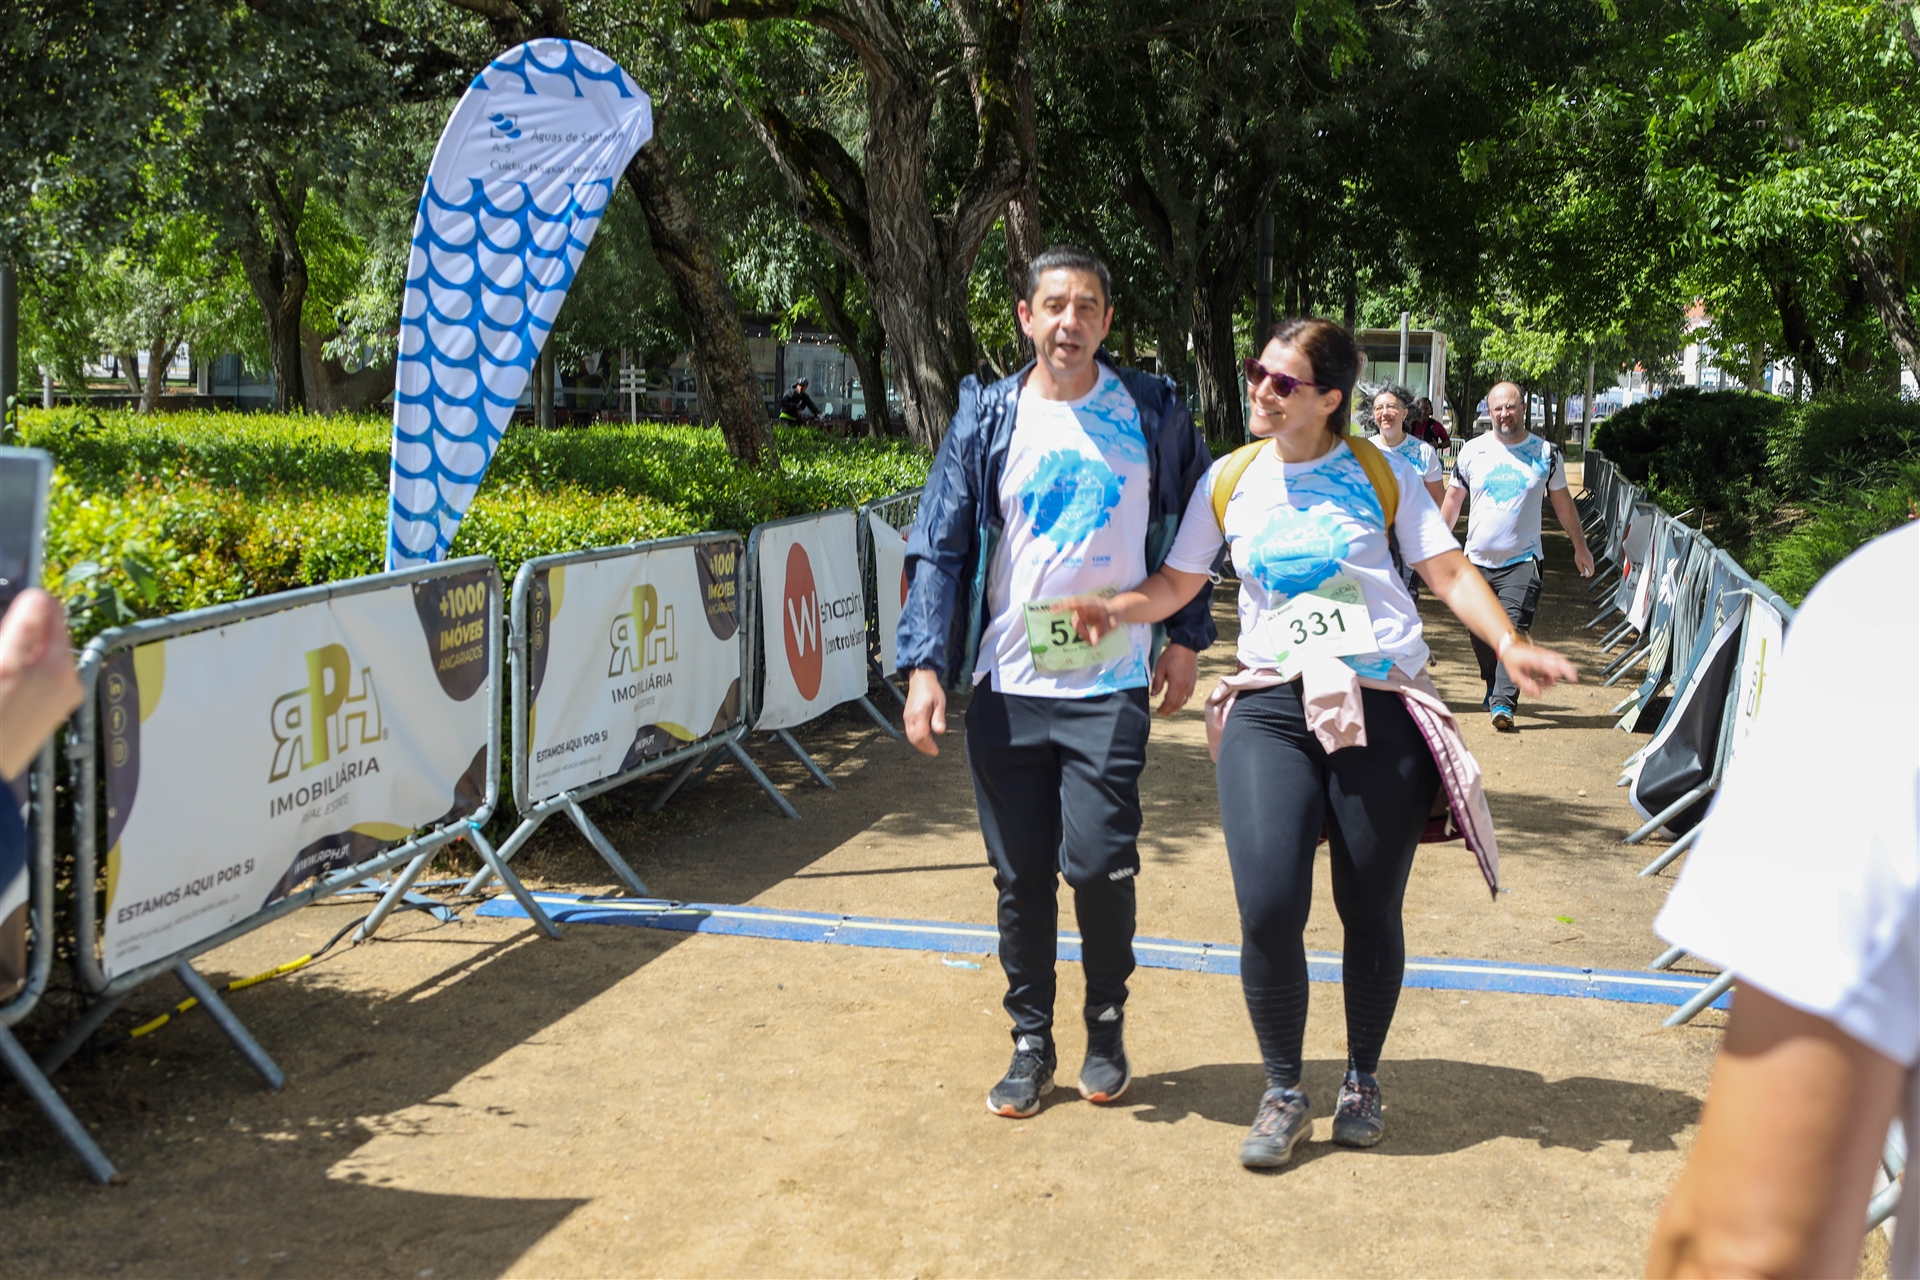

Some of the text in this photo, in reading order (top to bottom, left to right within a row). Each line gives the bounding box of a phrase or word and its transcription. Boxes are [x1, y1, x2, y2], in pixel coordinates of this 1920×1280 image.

[531, 128, 562, 143] Águas
[566, 132, 578, 142] de
[439, 581, 486, 619] +1000
[820, 591, 863, 624] shoppin
[440, 618, 484, 652] IMÓVEIS
[1289, 608, 1346, 645] 331
[438, 644, 483, 673] ANGARIADOS
[536, 730, 608, 763] ESTAMOS AQUI POR SI
[270, 757, 380, 818] IMOBILIÁRIA
[324, 792, 350, 816] ESTATE
[117, 858, 255, 924] ESTAMOS AQUI POR SI
